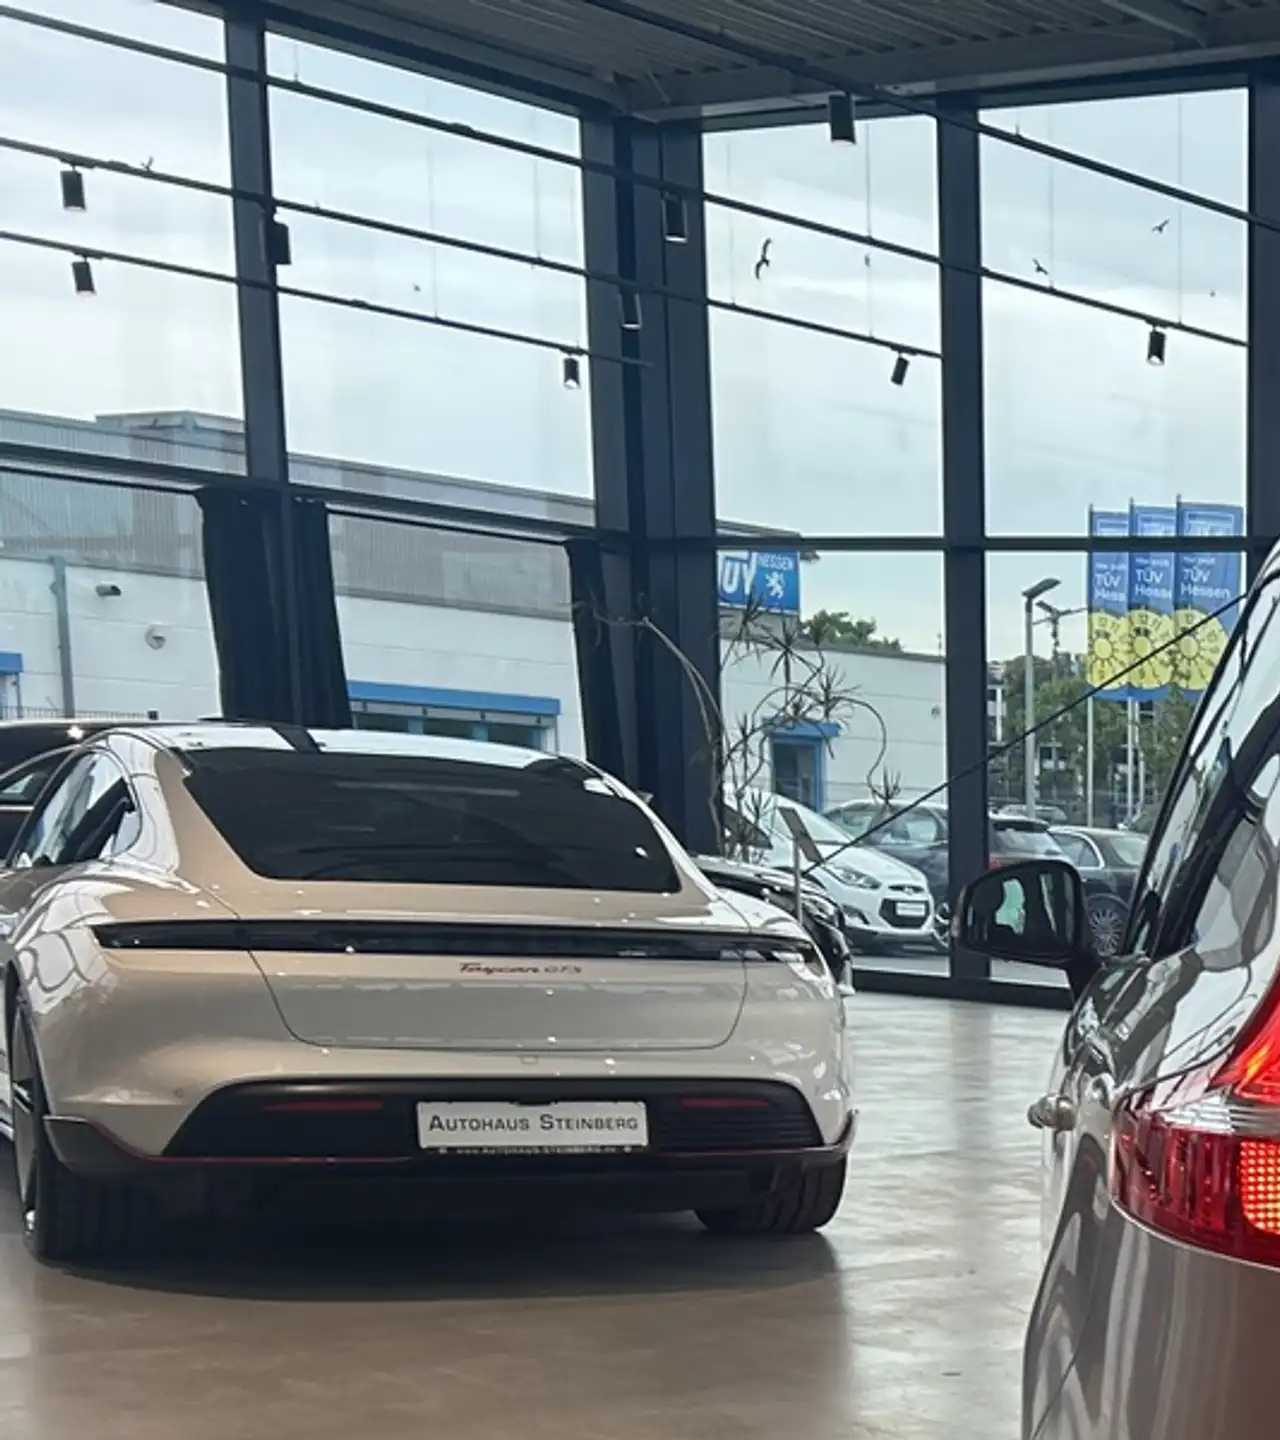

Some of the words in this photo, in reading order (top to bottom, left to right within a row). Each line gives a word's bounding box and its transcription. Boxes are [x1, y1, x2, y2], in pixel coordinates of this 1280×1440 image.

[1095, 571, 1121, 587] TÜV
[1135, 567, 1164, 584] TÜV
[1183, 565, 1211, 583] TÜV
[1180, 582, 1231, 599] Hessen
[428, 1114, 530, 1131] AUTOHAUS
[539, 1113, 638, 1131] STEINBERG
